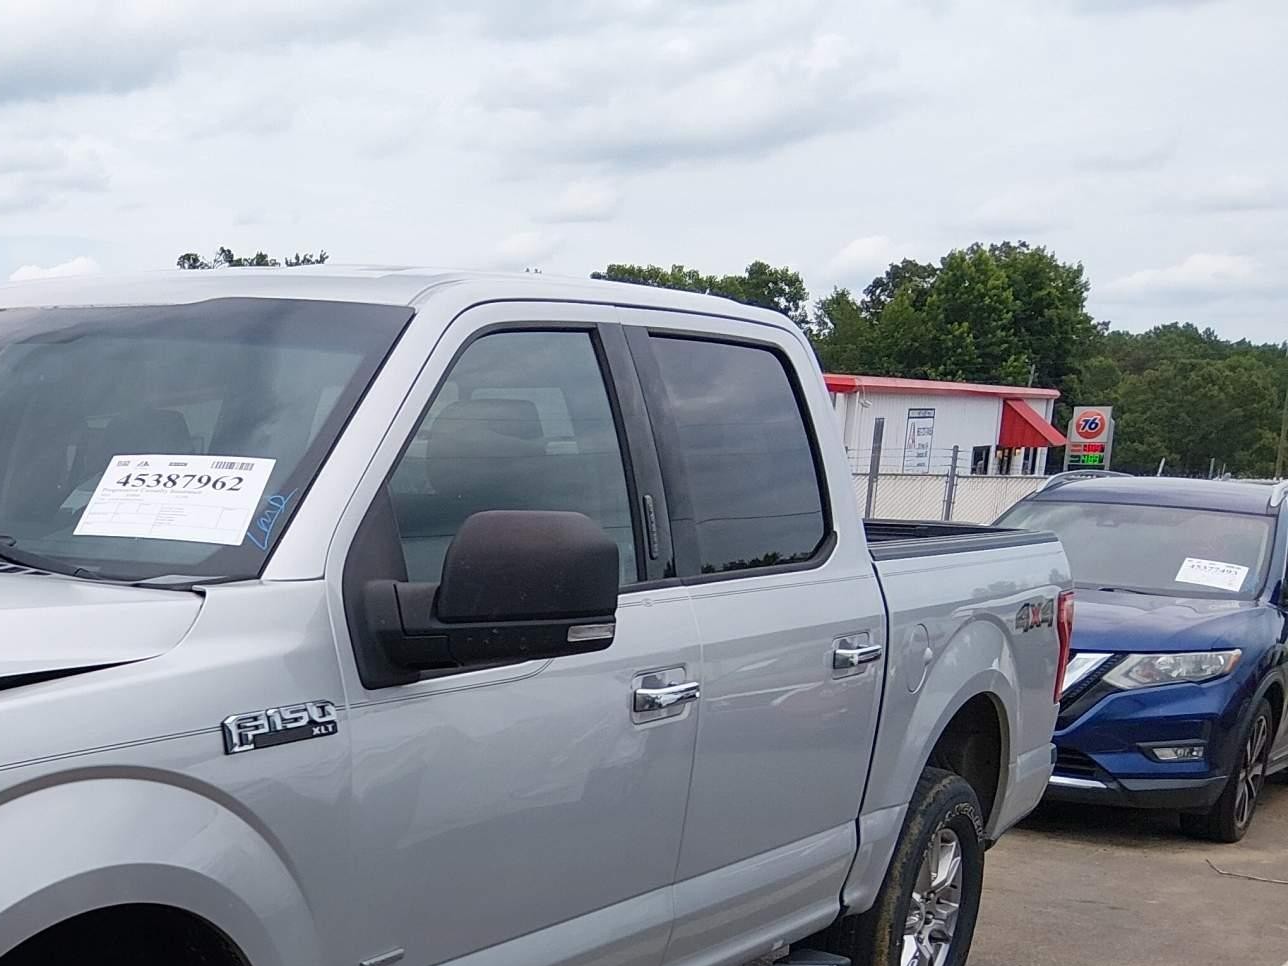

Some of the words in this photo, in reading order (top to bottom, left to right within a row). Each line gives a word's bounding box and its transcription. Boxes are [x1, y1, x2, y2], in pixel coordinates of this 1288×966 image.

[1079, 415, 1102, 433] 76
[116, 473, 244, 491] 45387962
[312, 724, 334, 736] XLT
